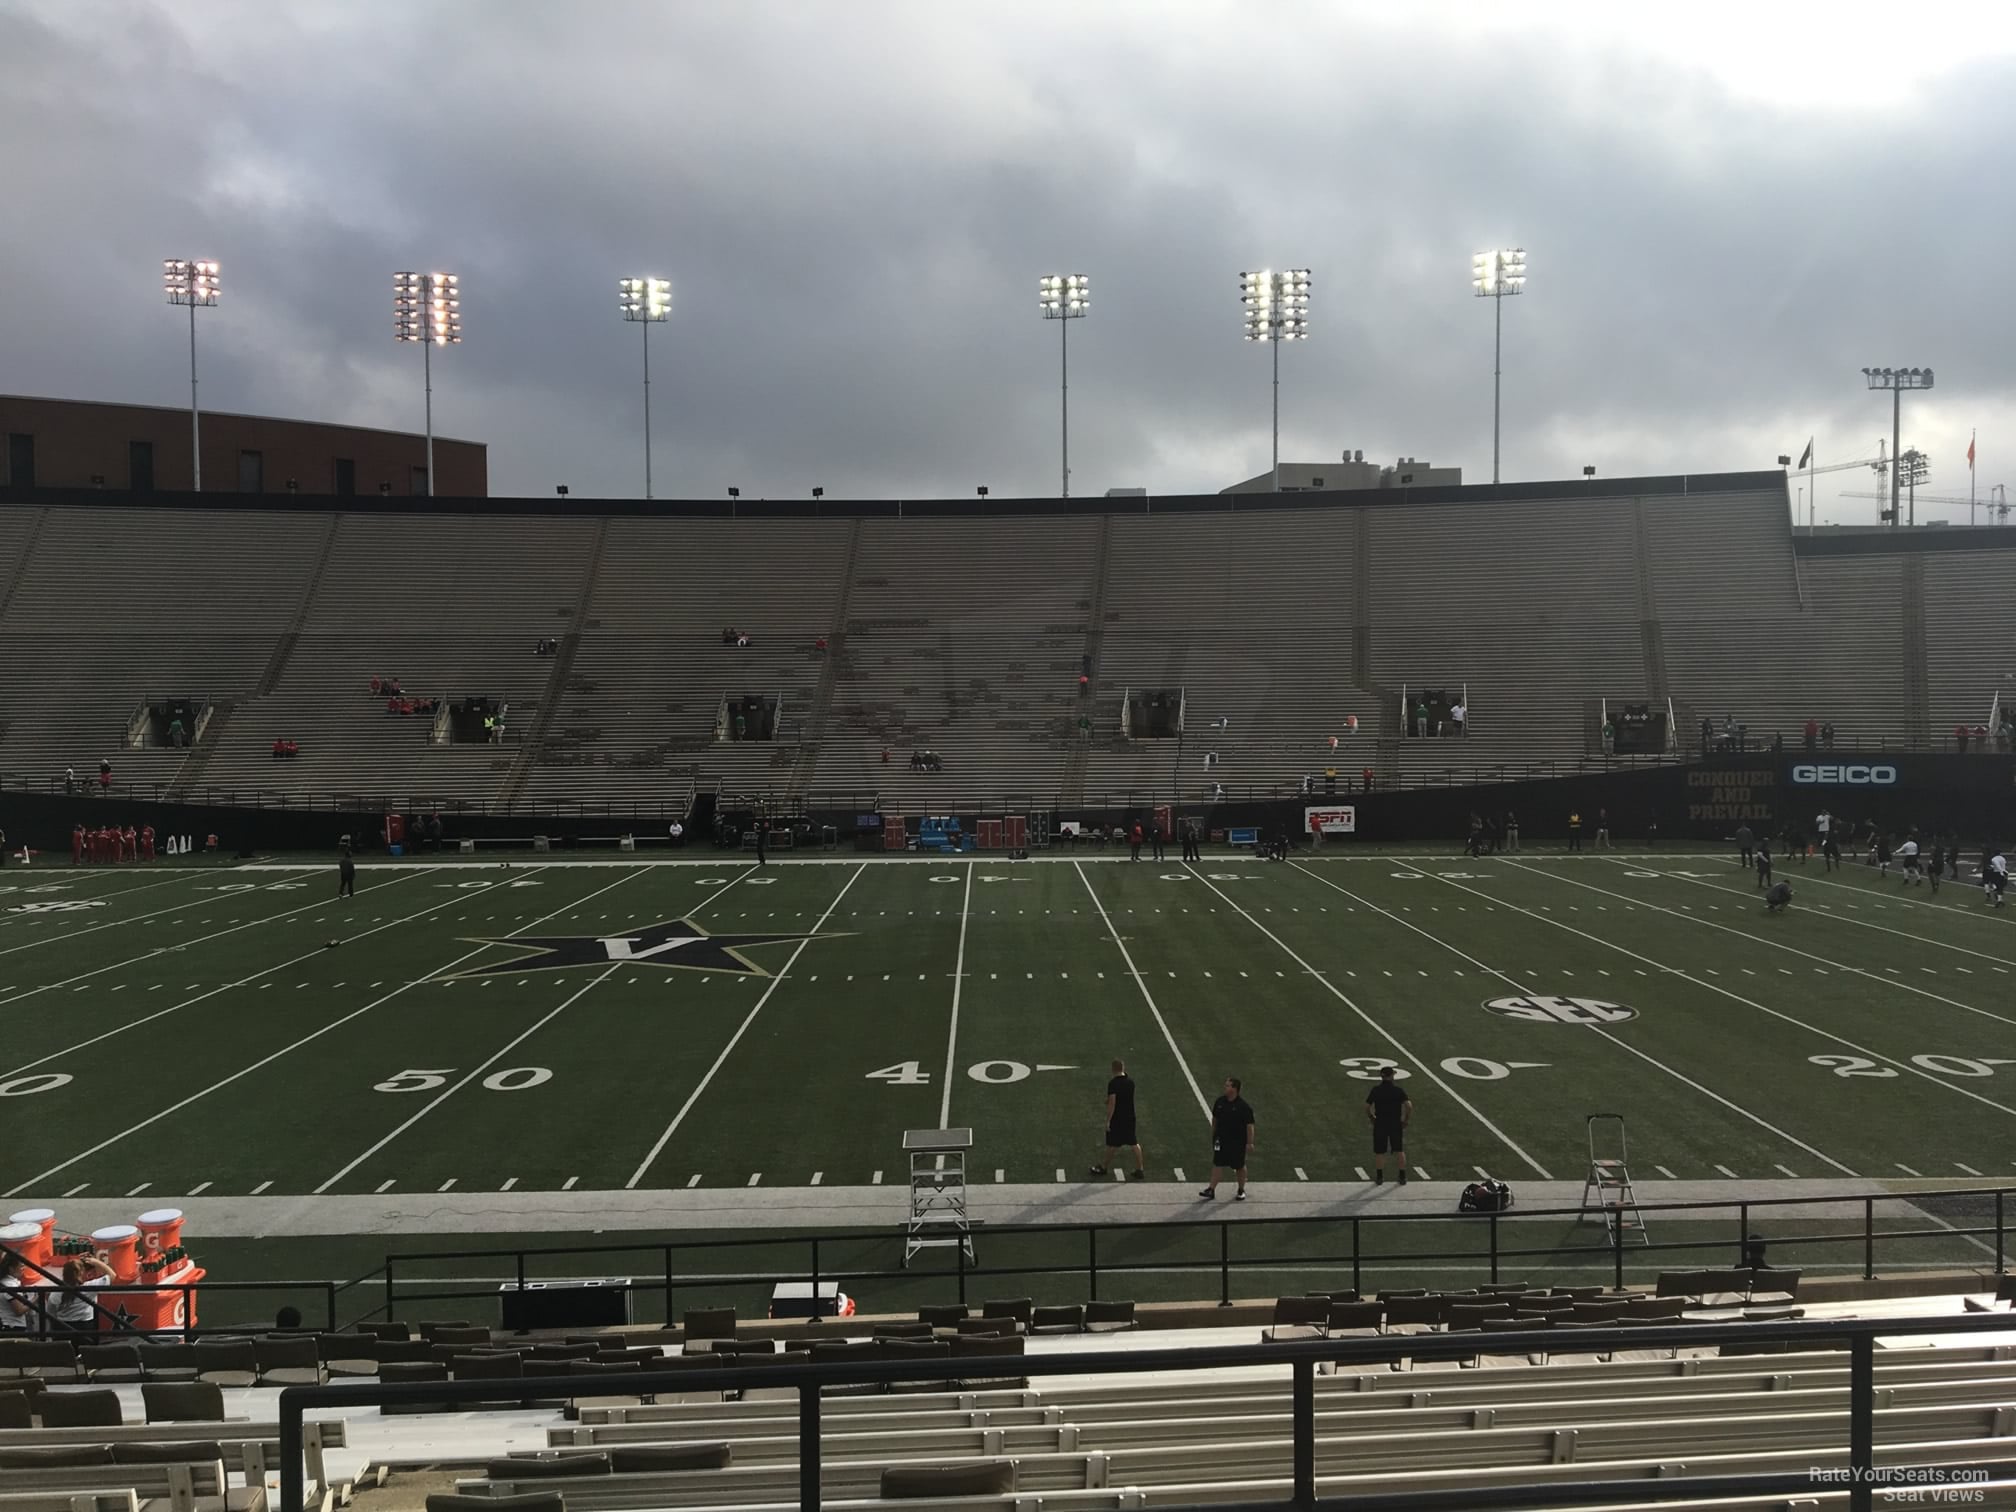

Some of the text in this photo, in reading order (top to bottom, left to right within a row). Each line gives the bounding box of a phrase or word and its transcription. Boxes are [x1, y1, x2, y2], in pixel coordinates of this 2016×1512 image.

[1687, 770, 1775, 786] CONQUER
[1792, 764, 1897, 784] GEICO
[1711, 787, 1752, 803] AND
[1687, 803, 1773, 820] PREVAIL
[1487, 996, 1634, 1023] SEC
[145, 1231, 160, 1248] G
[97, 1249, 109, 1264] G
